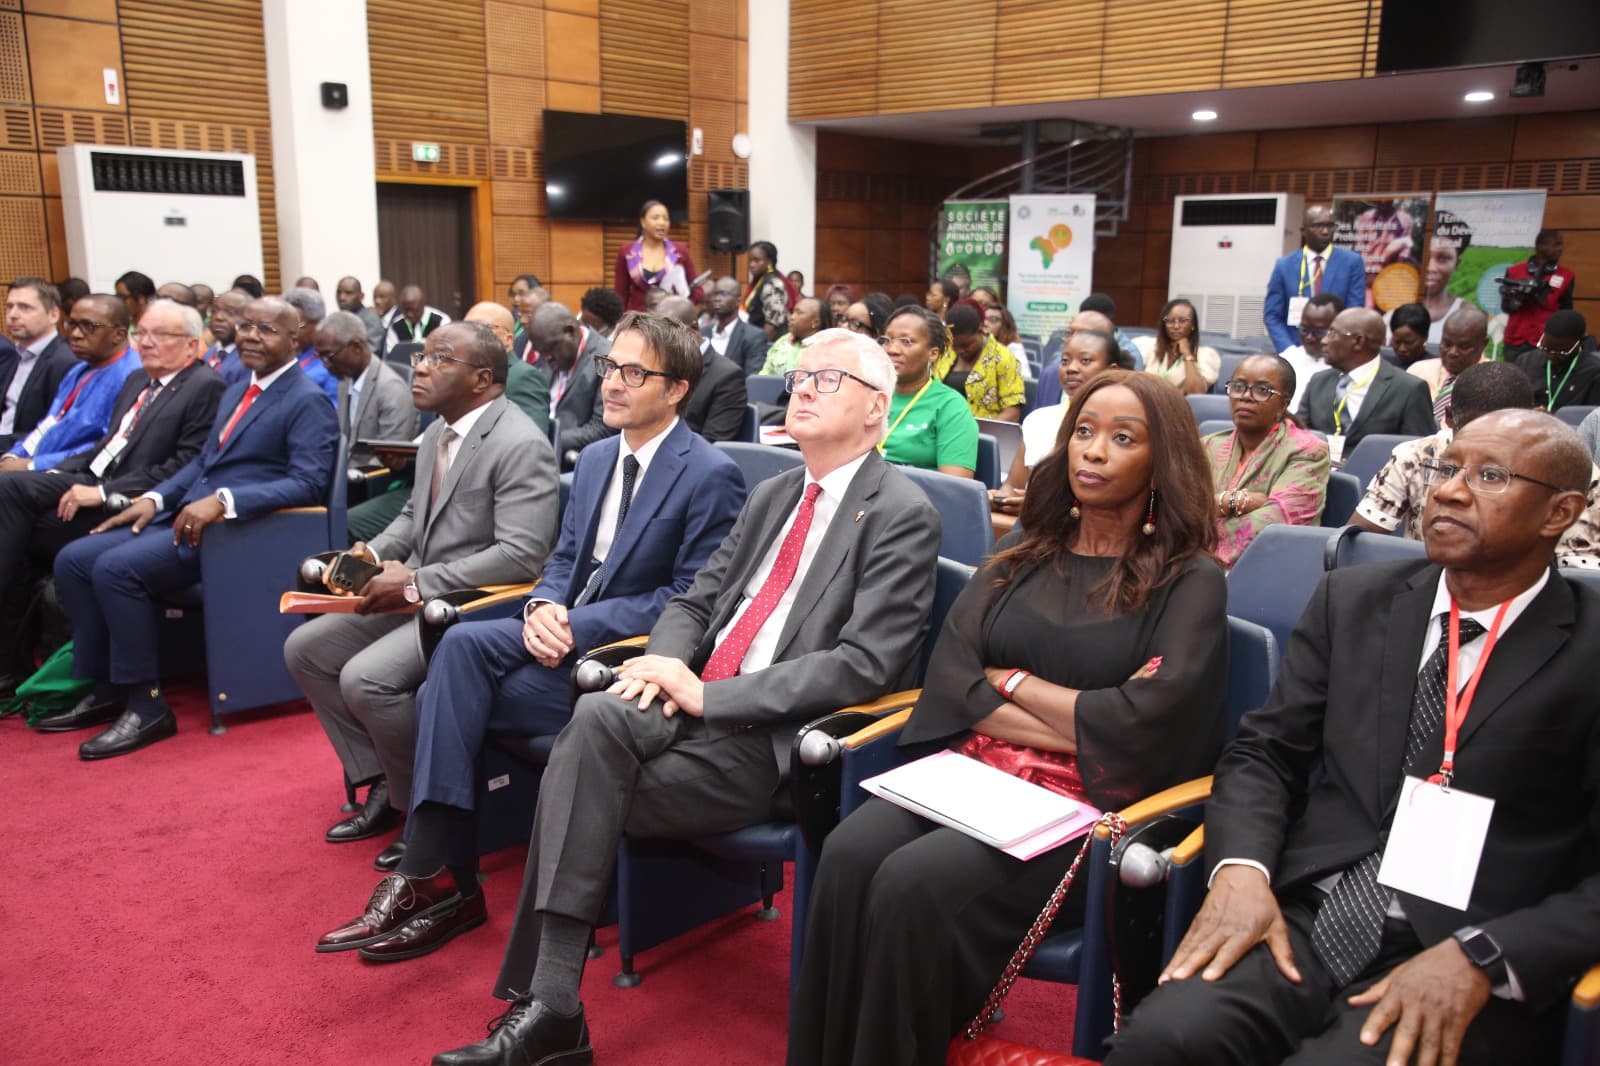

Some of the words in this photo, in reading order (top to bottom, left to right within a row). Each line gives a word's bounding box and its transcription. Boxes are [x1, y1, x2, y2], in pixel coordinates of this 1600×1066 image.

[947, 222, 990, 232] AFRICAINE
[992, 222, 1005, 232] DE
[946, 232, 1005, 242] PRIMATOLOGIE
